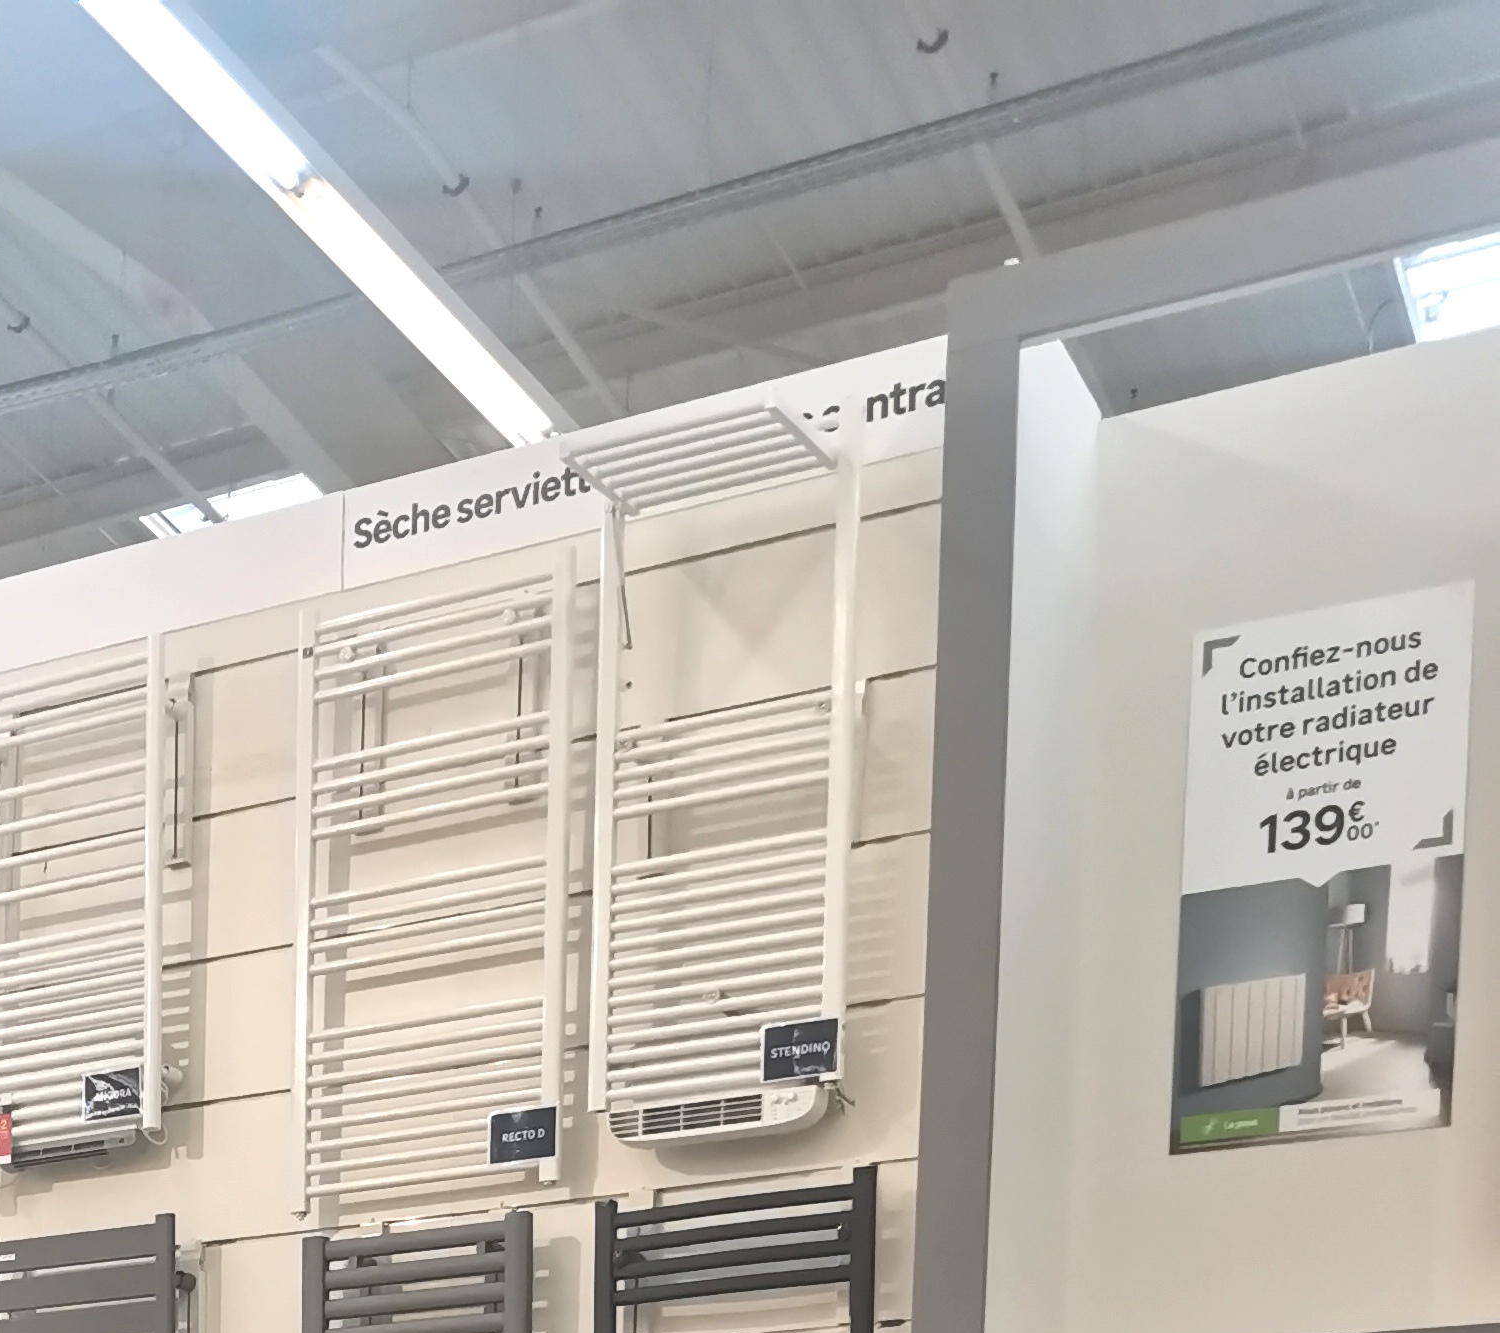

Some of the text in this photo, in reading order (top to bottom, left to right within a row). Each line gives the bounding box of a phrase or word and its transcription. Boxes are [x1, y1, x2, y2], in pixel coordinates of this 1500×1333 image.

[353, 502, 451, 549] Sèche
[457, 466, 591, 524] serviett
[1239, 631, 1422, 678] Confiez-nous
[1404, 659, 1438, 684] de
[1221, 697, 1435, 748] votre radiateur
[1254, 736, 1397, 776] électrique
[1343, 778, 1362, 792] de
[1259, 804, 1345, 854] 139
[1348, 801, 1366, 823] €
[770, 1040, 831, 1059] STENDINO
[501, 1128, 546, 1143] RECTO D
